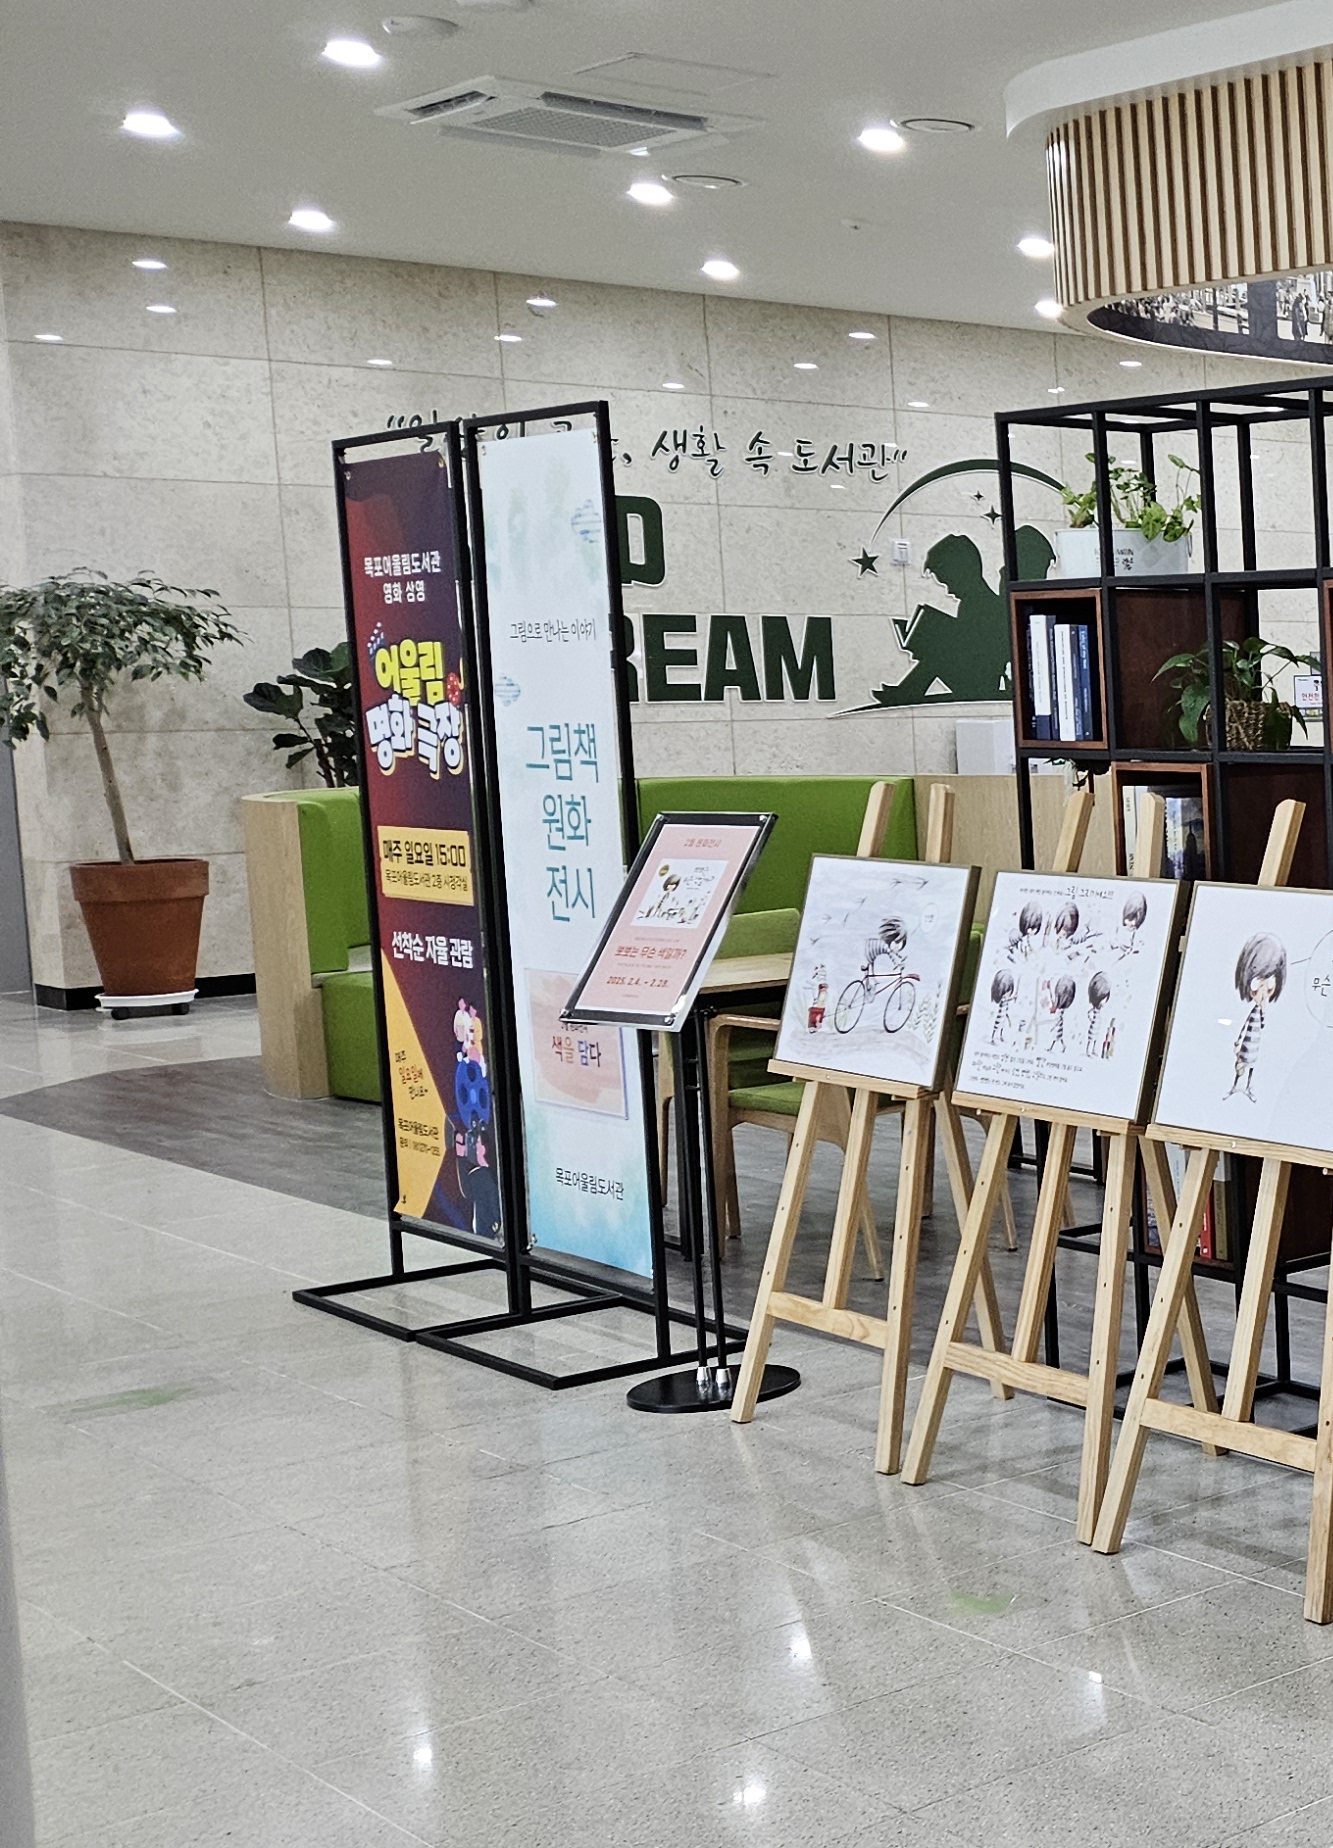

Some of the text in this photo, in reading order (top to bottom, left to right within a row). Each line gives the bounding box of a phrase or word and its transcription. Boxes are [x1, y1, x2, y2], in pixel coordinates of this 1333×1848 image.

[651, 425, 727, 477] 생활
[744, 430, 774, 476] 속
[364, 550, 442, 578] 목포어울림도서관
[383, 580, 426, 604] 영화 상영
[509, 618, 597, 643] 그림으로 만나는 이야기
[375, 638, 445, 707] 어울림
[525, 722, 600, 784] 그림책
[541, 793, 592, 851] 원화
[382, 840, 467, 868] 매주 일요일 15:00
[546, 865, 597, 922] 전시
[391, 930, 475, 969] 선착순 자율 관람
[640, 946, 657, 959] 무슨
[1312, 975, 1332, 997] 무슨
[552, 1036, 602, 1068] 색을 담다
[555, 1167, 625, 1201] 목포어울림도서관
